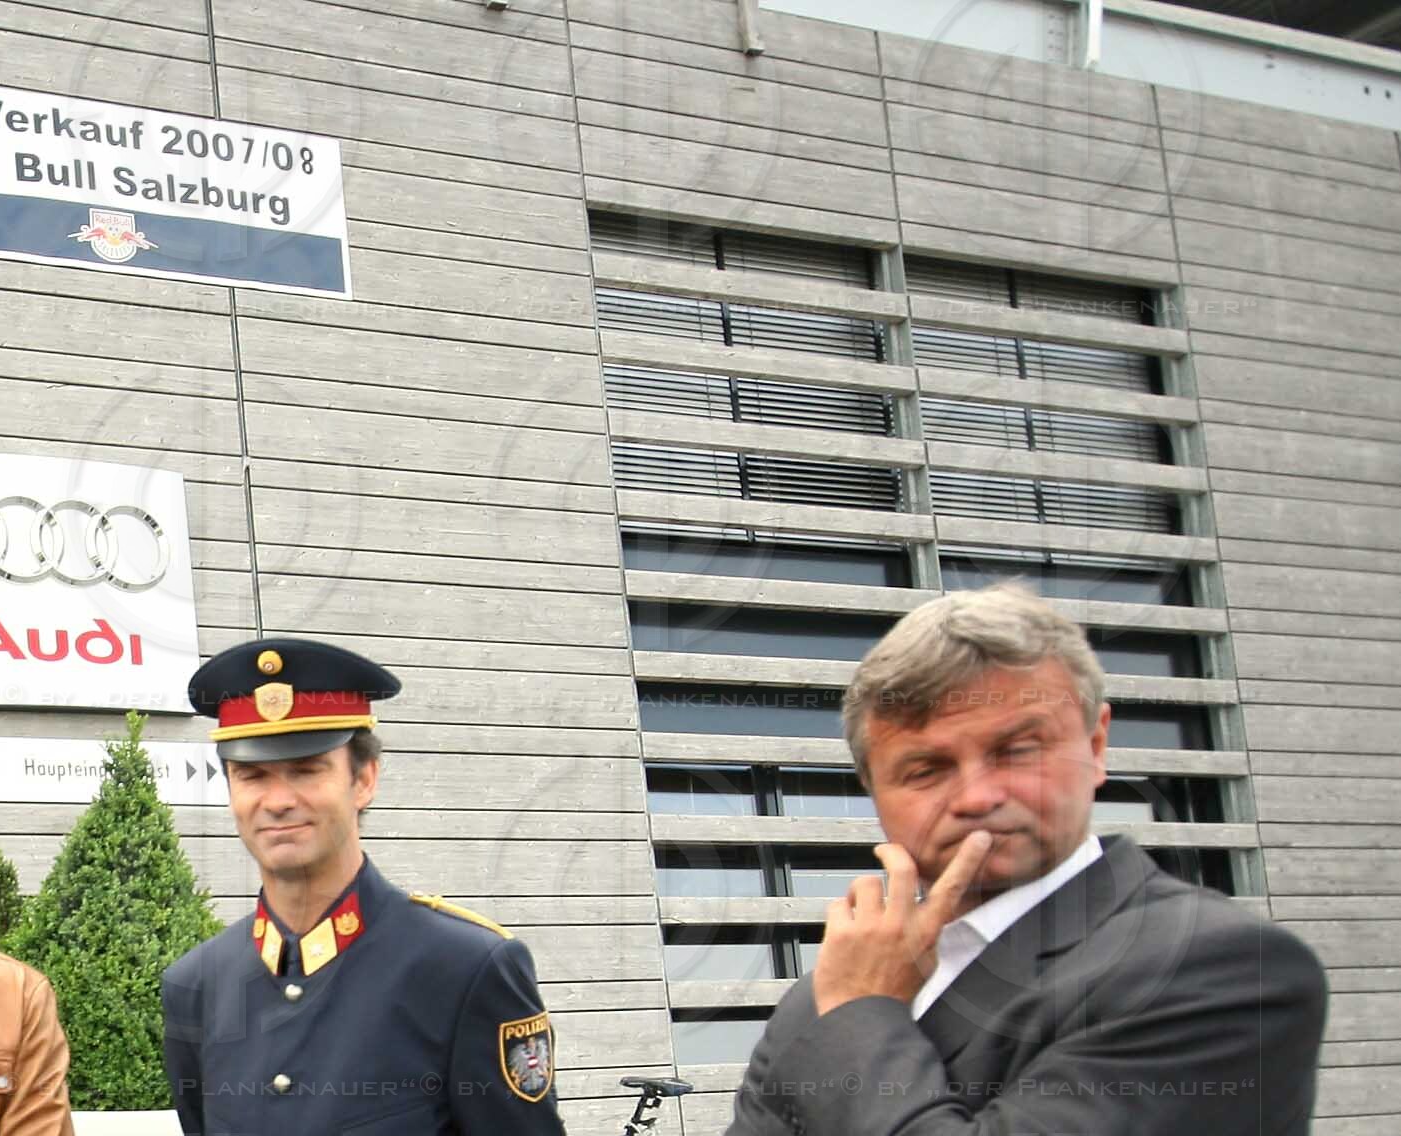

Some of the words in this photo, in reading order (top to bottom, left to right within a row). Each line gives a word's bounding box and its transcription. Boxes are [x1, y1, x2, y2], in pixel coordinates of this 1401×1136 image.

[161, 124, 315, 177] 2007/08
[15, 151, 97, 192] Bull
[113, 166, 291, 227] Salzburg
